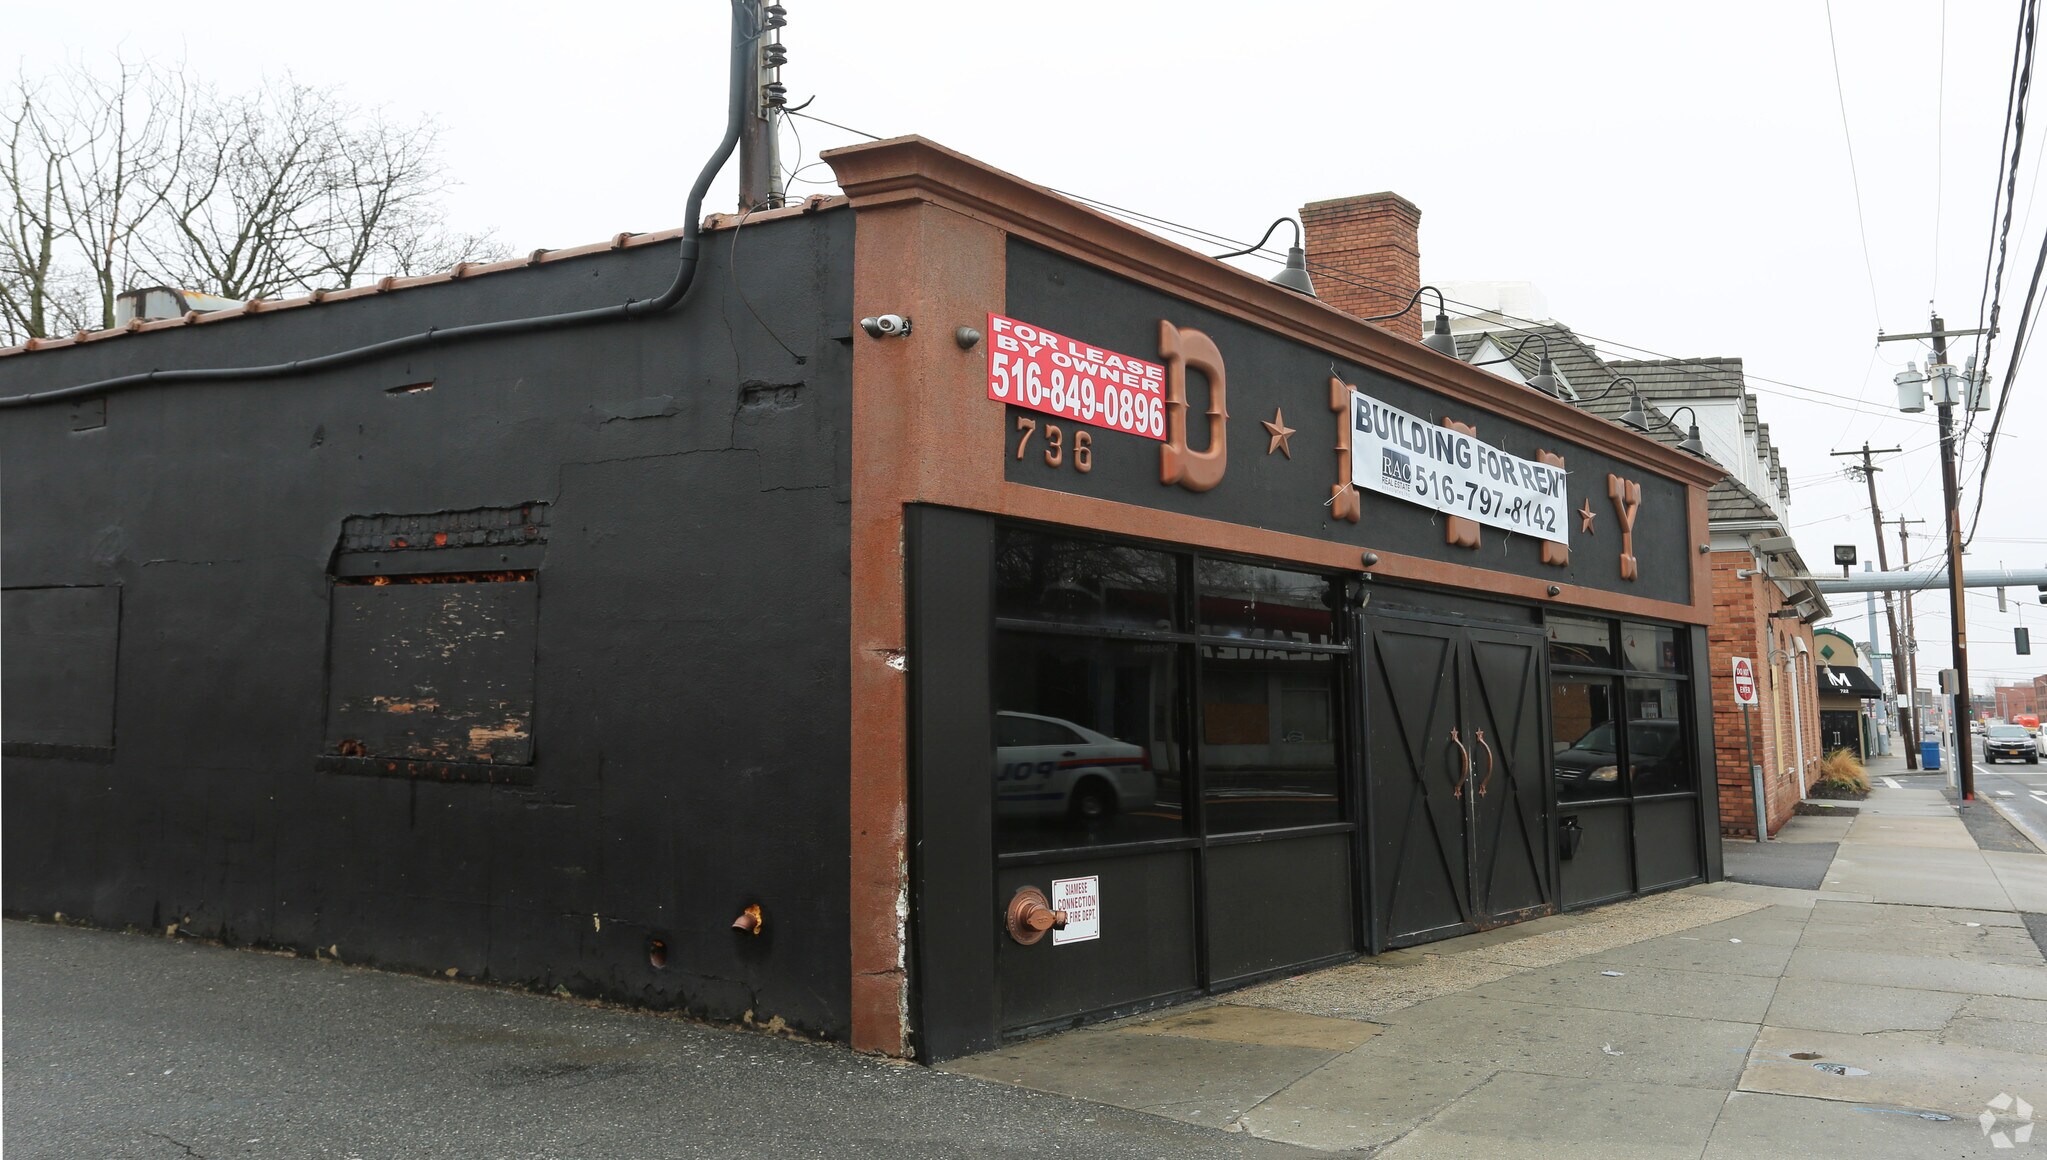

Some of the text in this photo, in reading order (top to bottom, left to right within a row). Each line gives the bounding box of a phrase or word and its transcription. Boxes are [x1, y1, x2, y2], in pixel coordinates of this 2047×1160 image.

[993, 317, 1163, 381] FOR LEASE
[997, 334, 1161, 394] BY OWNER
[991, 352, 1164, 437] 516-849-0896
[1017, 416, 1092, 473] 736
[1355, 397, 1471, 469] BUILDING
[1477, 445, 1519, 486] FOR
[1382, 476, 1393, 486] REAL
[1394, 480, 1410, 491] ESTATE
[1383, 456, 1411, 481] RAC
[1415, 465, 1556, 533] 516-797-8142
[1736, 668, 1743, 676] DO
[1057, 895, 1096, 910] CONNECTION
[1065, 882, 1087, 896] SIAMESE
[1070, 911, 1081, 923] FIRE
